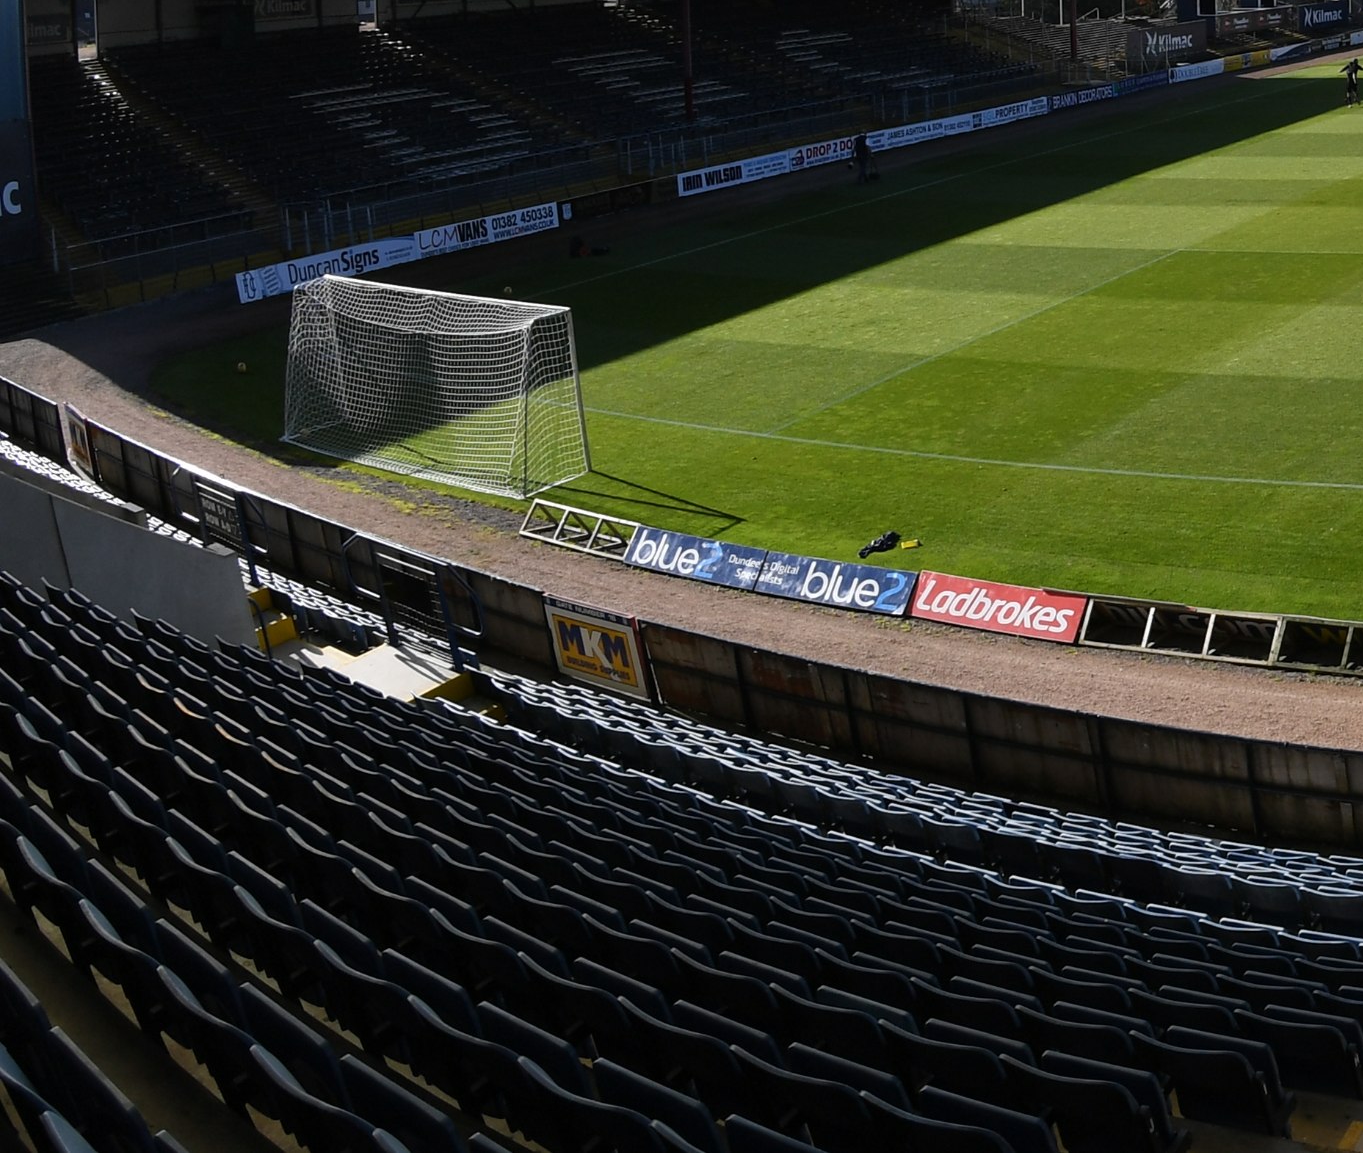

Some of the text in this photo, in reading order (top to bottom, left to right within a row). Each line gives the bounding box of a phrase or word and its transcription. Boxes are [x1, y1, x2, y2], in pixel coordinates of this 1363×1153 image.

[267, 0, 306, 13] Kilmac
[1313, 8, 1342, 23] Kilmac
[1158, 33, 1193, 53] Kilmac
[1053, 93, 1078, 109] BRANKIN
[1078, 86, 1112, 105] DECORATORS
[806, 143, 831, 160] DROP
[683, 173, 702, 192] IAIN
[704, 165, 742, 187] WILSON
[492, 205, 554, 230] 01382 450338
[728, 555, 800, 575] Dundee's Digital
[735, 568, 782, 586] Specialists
[917, 581, 1076, 634] Ladbrokes
[558, 620, 630, 680] MKM
